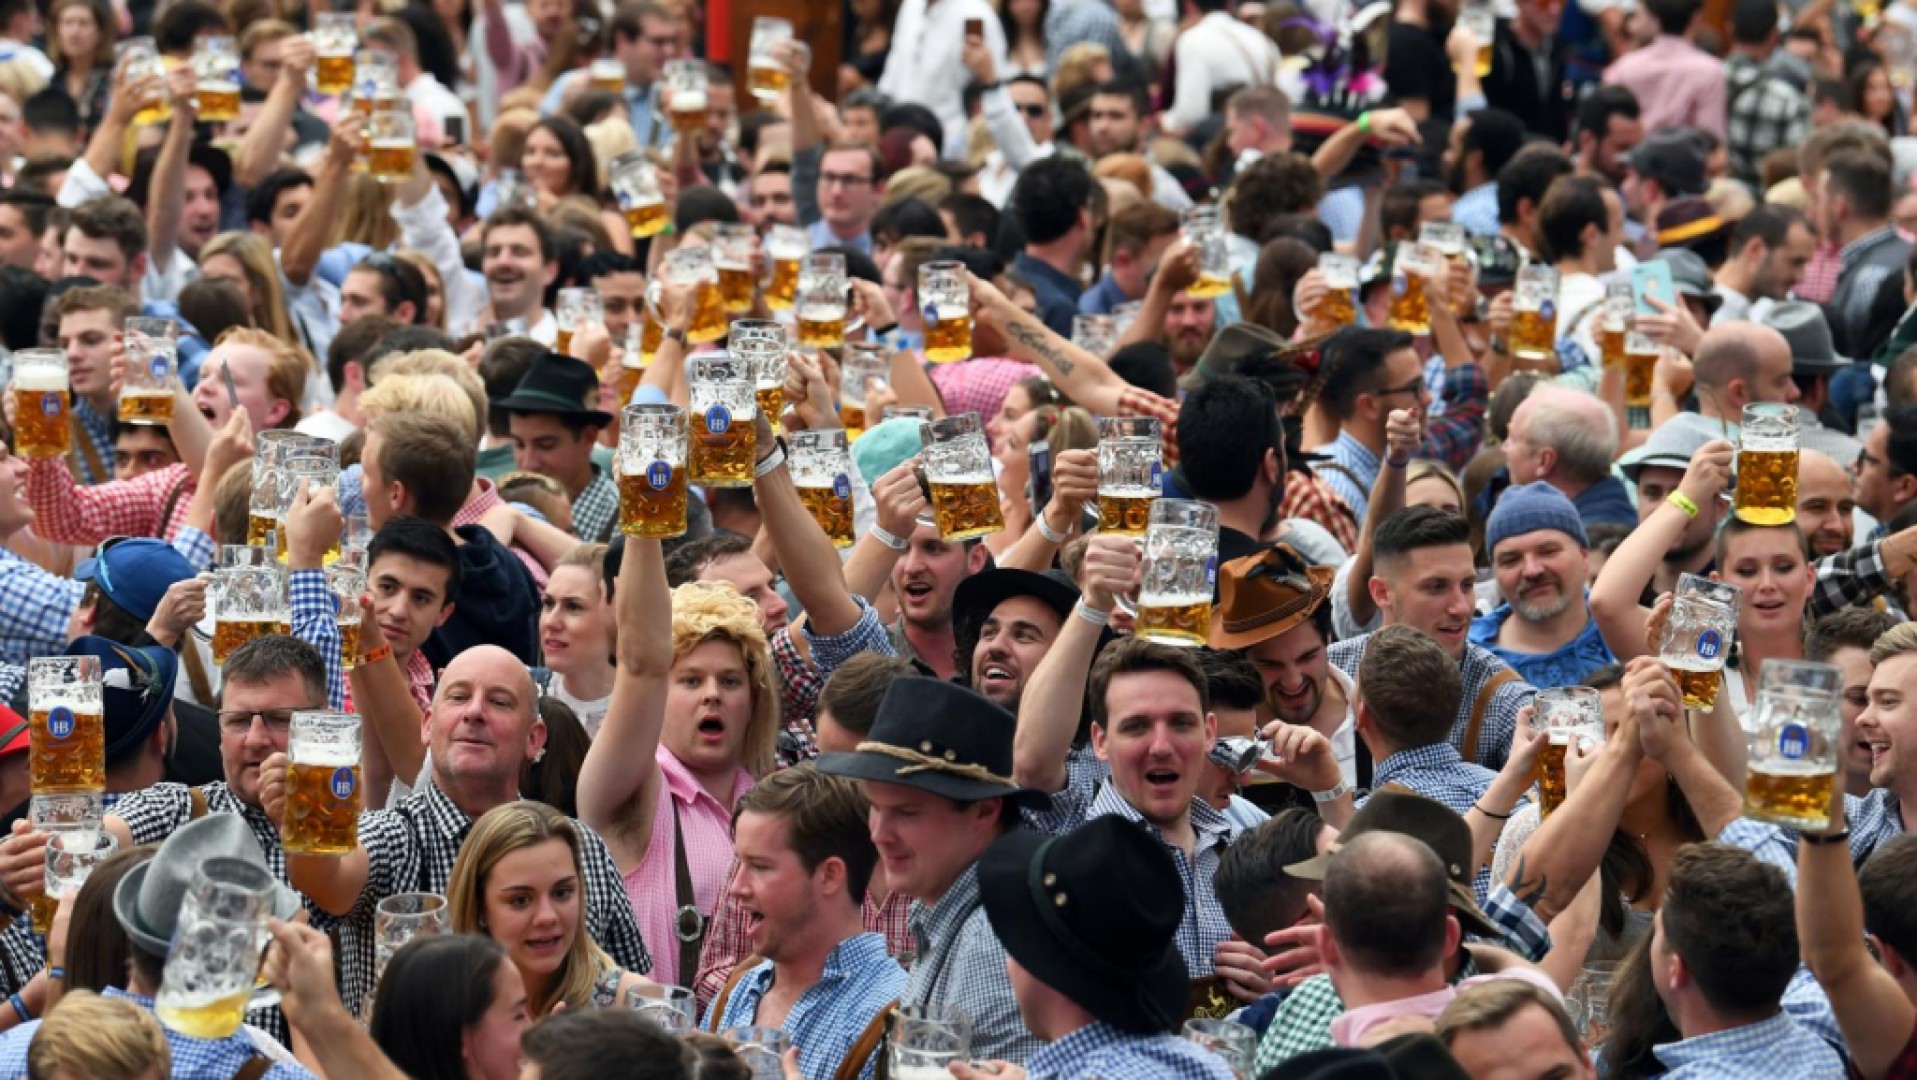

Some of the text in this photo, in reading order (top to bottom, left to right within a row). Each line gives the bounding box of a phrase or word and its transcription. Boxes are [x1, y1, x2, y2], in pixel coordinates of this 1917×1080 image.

[711, 419, 725, 430] HB
[653, 473, 666, 485] HB
[1701, 642, 1715, 655] HB
[54, 721, 69, 733] HB
[337, 782, 350, 794] HB
